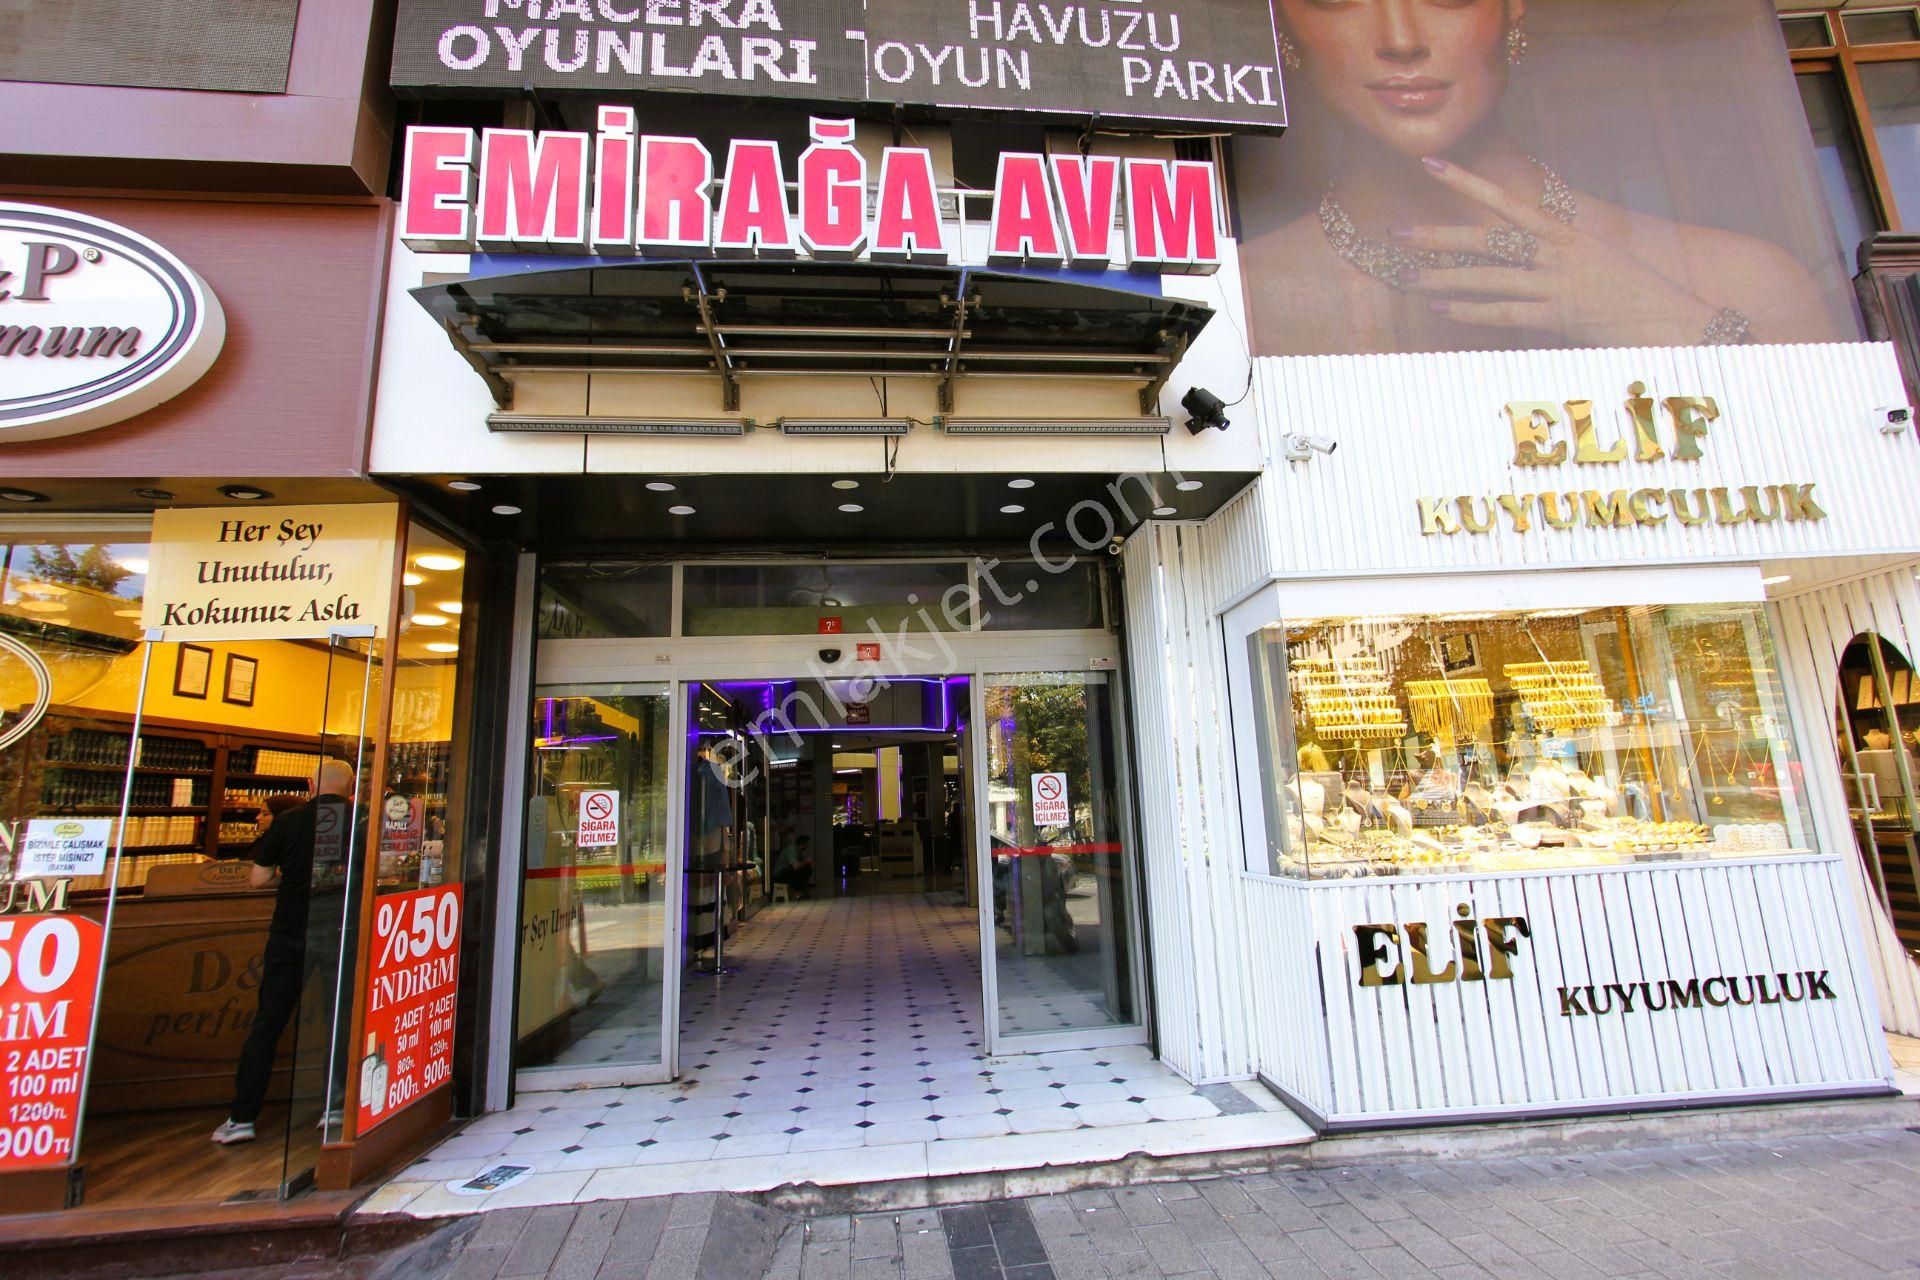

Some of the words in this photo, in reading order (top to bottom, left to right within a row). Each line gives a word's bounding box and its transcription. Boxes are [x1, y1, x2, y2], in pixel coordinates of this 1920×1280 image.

[970, 0, 1180, 53] HAVUZU
[438, 26, 816, 84] OYUNLARI
[873, 42, 1031, 90] OYUN
[1123, 57, 1278, 106] PARKI
[400, 105, 948, 264] EMİRAĞA
[988, 152, 1222, 275] AVM
[1504, 381, 1720, 467] ELİF
[1416, 482, 1828, 536] KUYUMCULUK
[217, 520, 270, 543] Her
[277, 519, 323, 551] Şey
[198, 555, 333, 585] Unutulur,
[161, 598, 292, 626] Kokunuz
[297, 594, 361, 622] Asla
[1035, 800, 1066, 812] SİGARA
[1035, 811, 1067, 823] İÇİLMEZ
[581, 820, 616, 832] SİGARA
[581, 832, 616, 844] İÇİLMEZ
[378, 892, 459, 969] %50
[1352, 903, 1530, 987] ELİF
[428, 1003, 434, 1018] 2
[435, 994, 455, 1015] ADET
[1557, 970, 1837, 1016] KUYUMCULUK
[0, 1000, 72, 1042] iM
[394, 1016, 400, 1034] 2
[401, 1005, 425, 1032] ADET
[430, 1018, 443, 1038] 100
[443, 1013, 452, 1033] ml
[397, 1035, 407, 1053] 50
[408, 1029, 419, 1048] ml
[6, 1051, 20, 1072] 2
[24, 1046, 87, 1071] ADET
[9, 1075, 46, 1098] 100
[51, 1073, 78, 1094] ml
